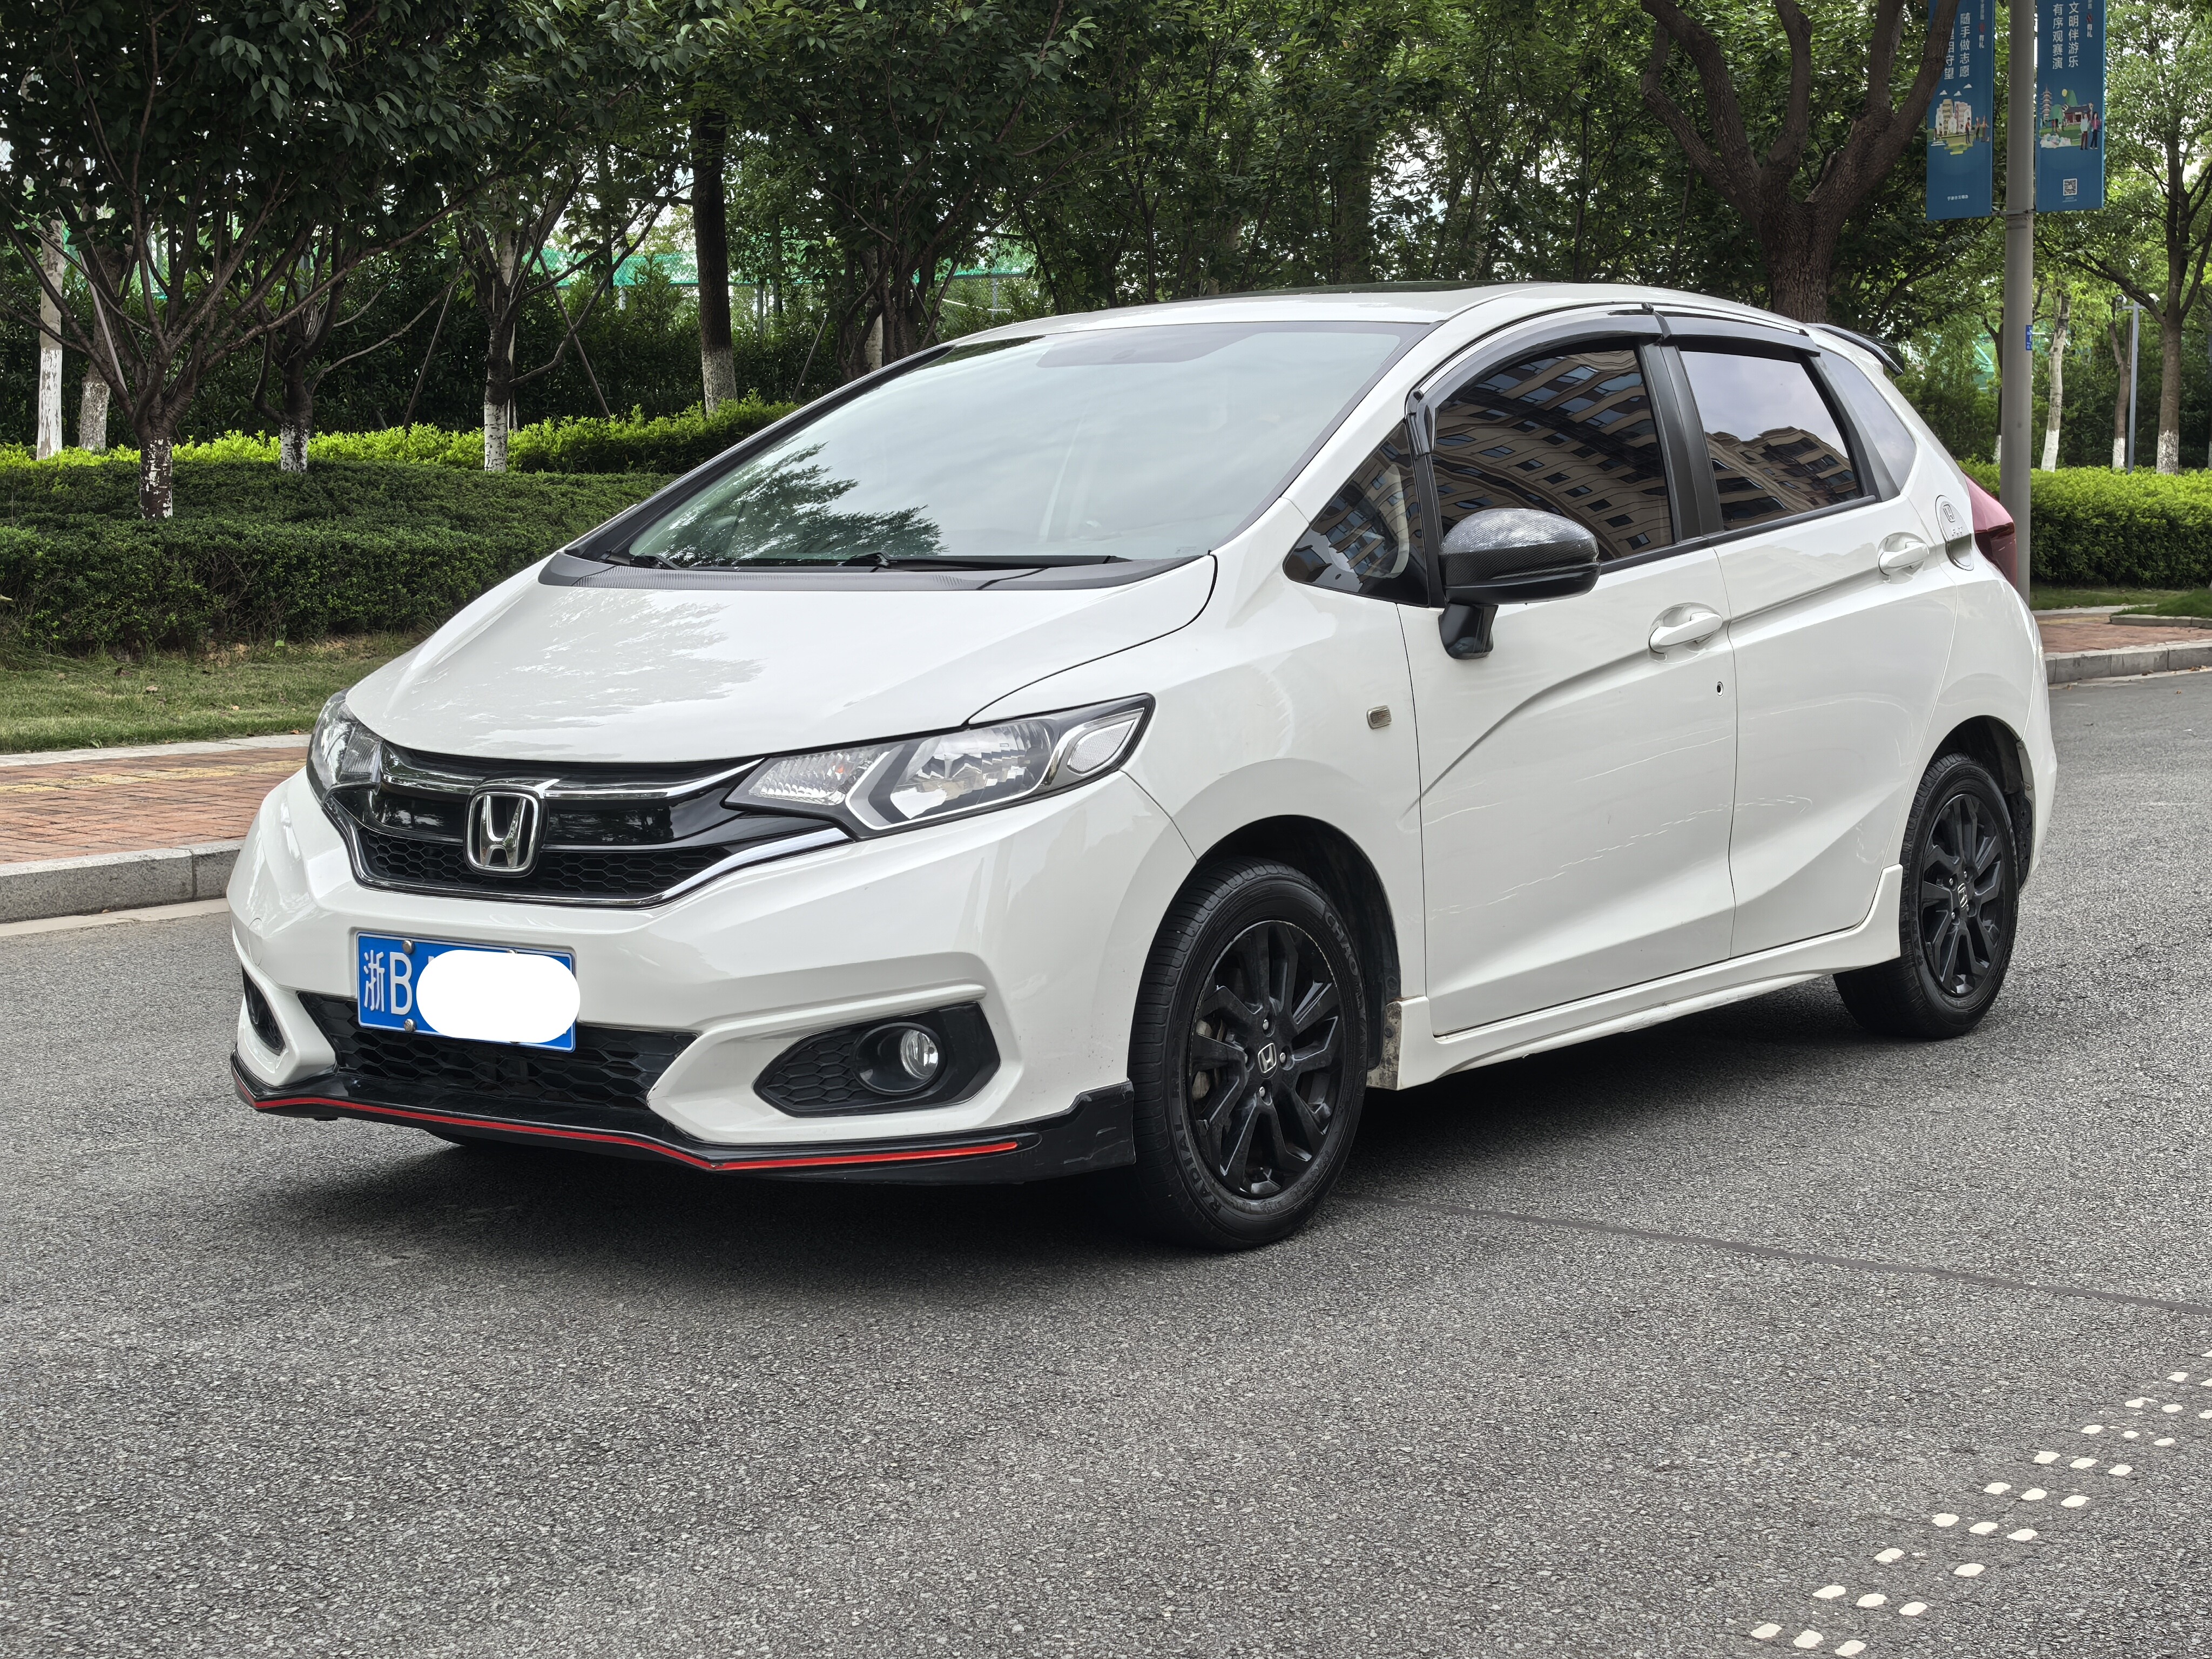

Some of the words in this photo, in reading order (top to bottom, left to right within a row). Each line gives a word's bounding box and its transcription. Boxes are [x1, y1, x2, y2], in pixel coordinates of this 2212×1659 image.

[1959, 12, 1971, 77] 随手做志愿
[2052, 3, 2063, 70] 有序观赛演
[2068, 1, 2079, 68] 文明伴游乐
[1325, 912, 1359, 976] CHAO
[363, 949, 413, 1015] 浙B
